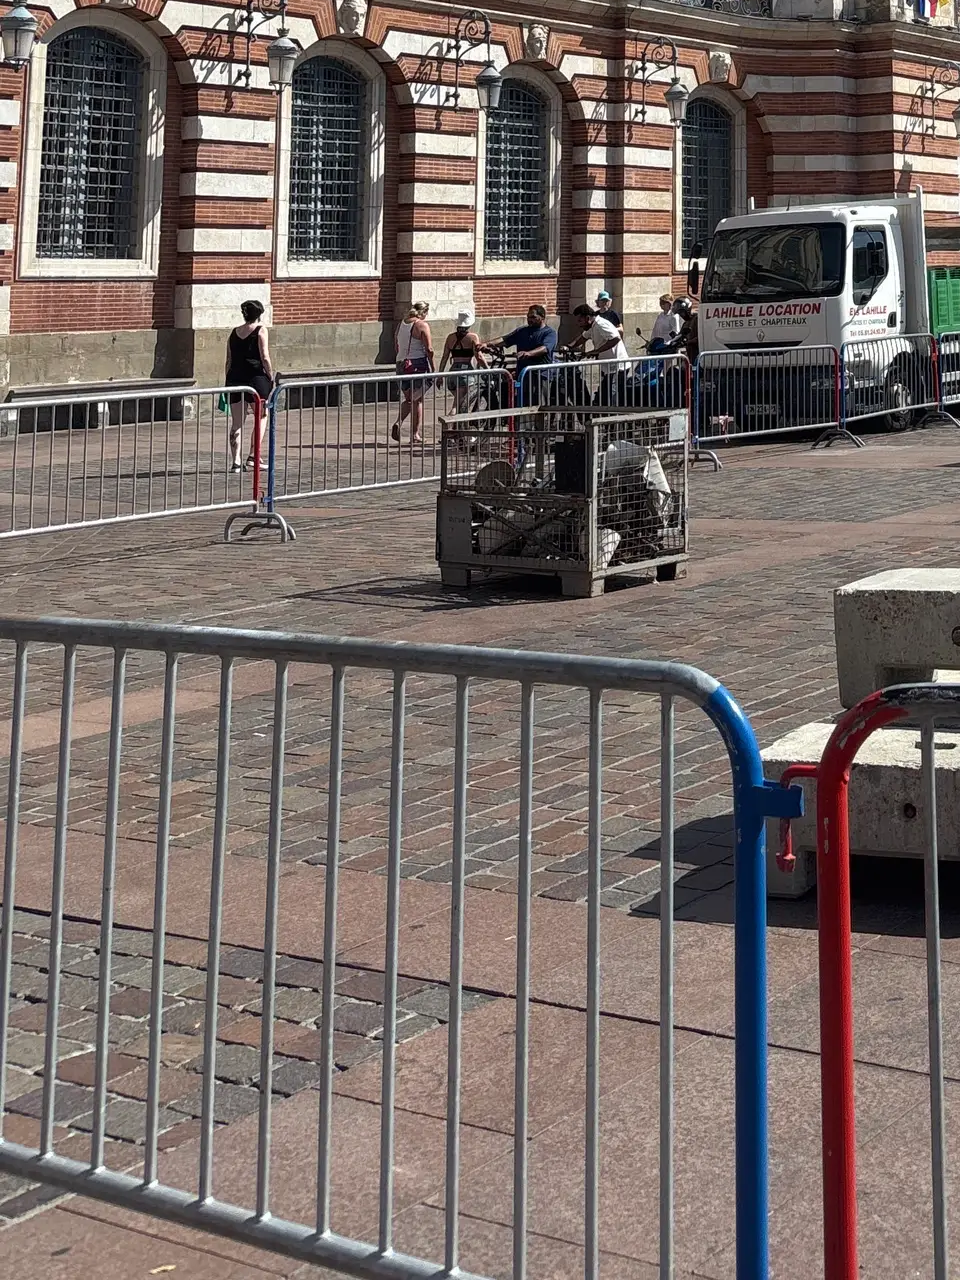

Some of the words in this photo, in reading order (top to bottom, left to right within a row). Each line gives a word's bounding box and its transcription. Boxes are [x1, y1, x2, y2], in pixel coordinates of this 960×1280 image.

[706, 306, 754, 320] LAHILLE
[758, 303, 822, 317] LOCATION
[862, 305, 887, 316] LAHILLE
[717, 320, 744, 328] TENTES
[748, 319, 757, 327] ET
[761, 317, 807, 326] CHAPITEAUX
